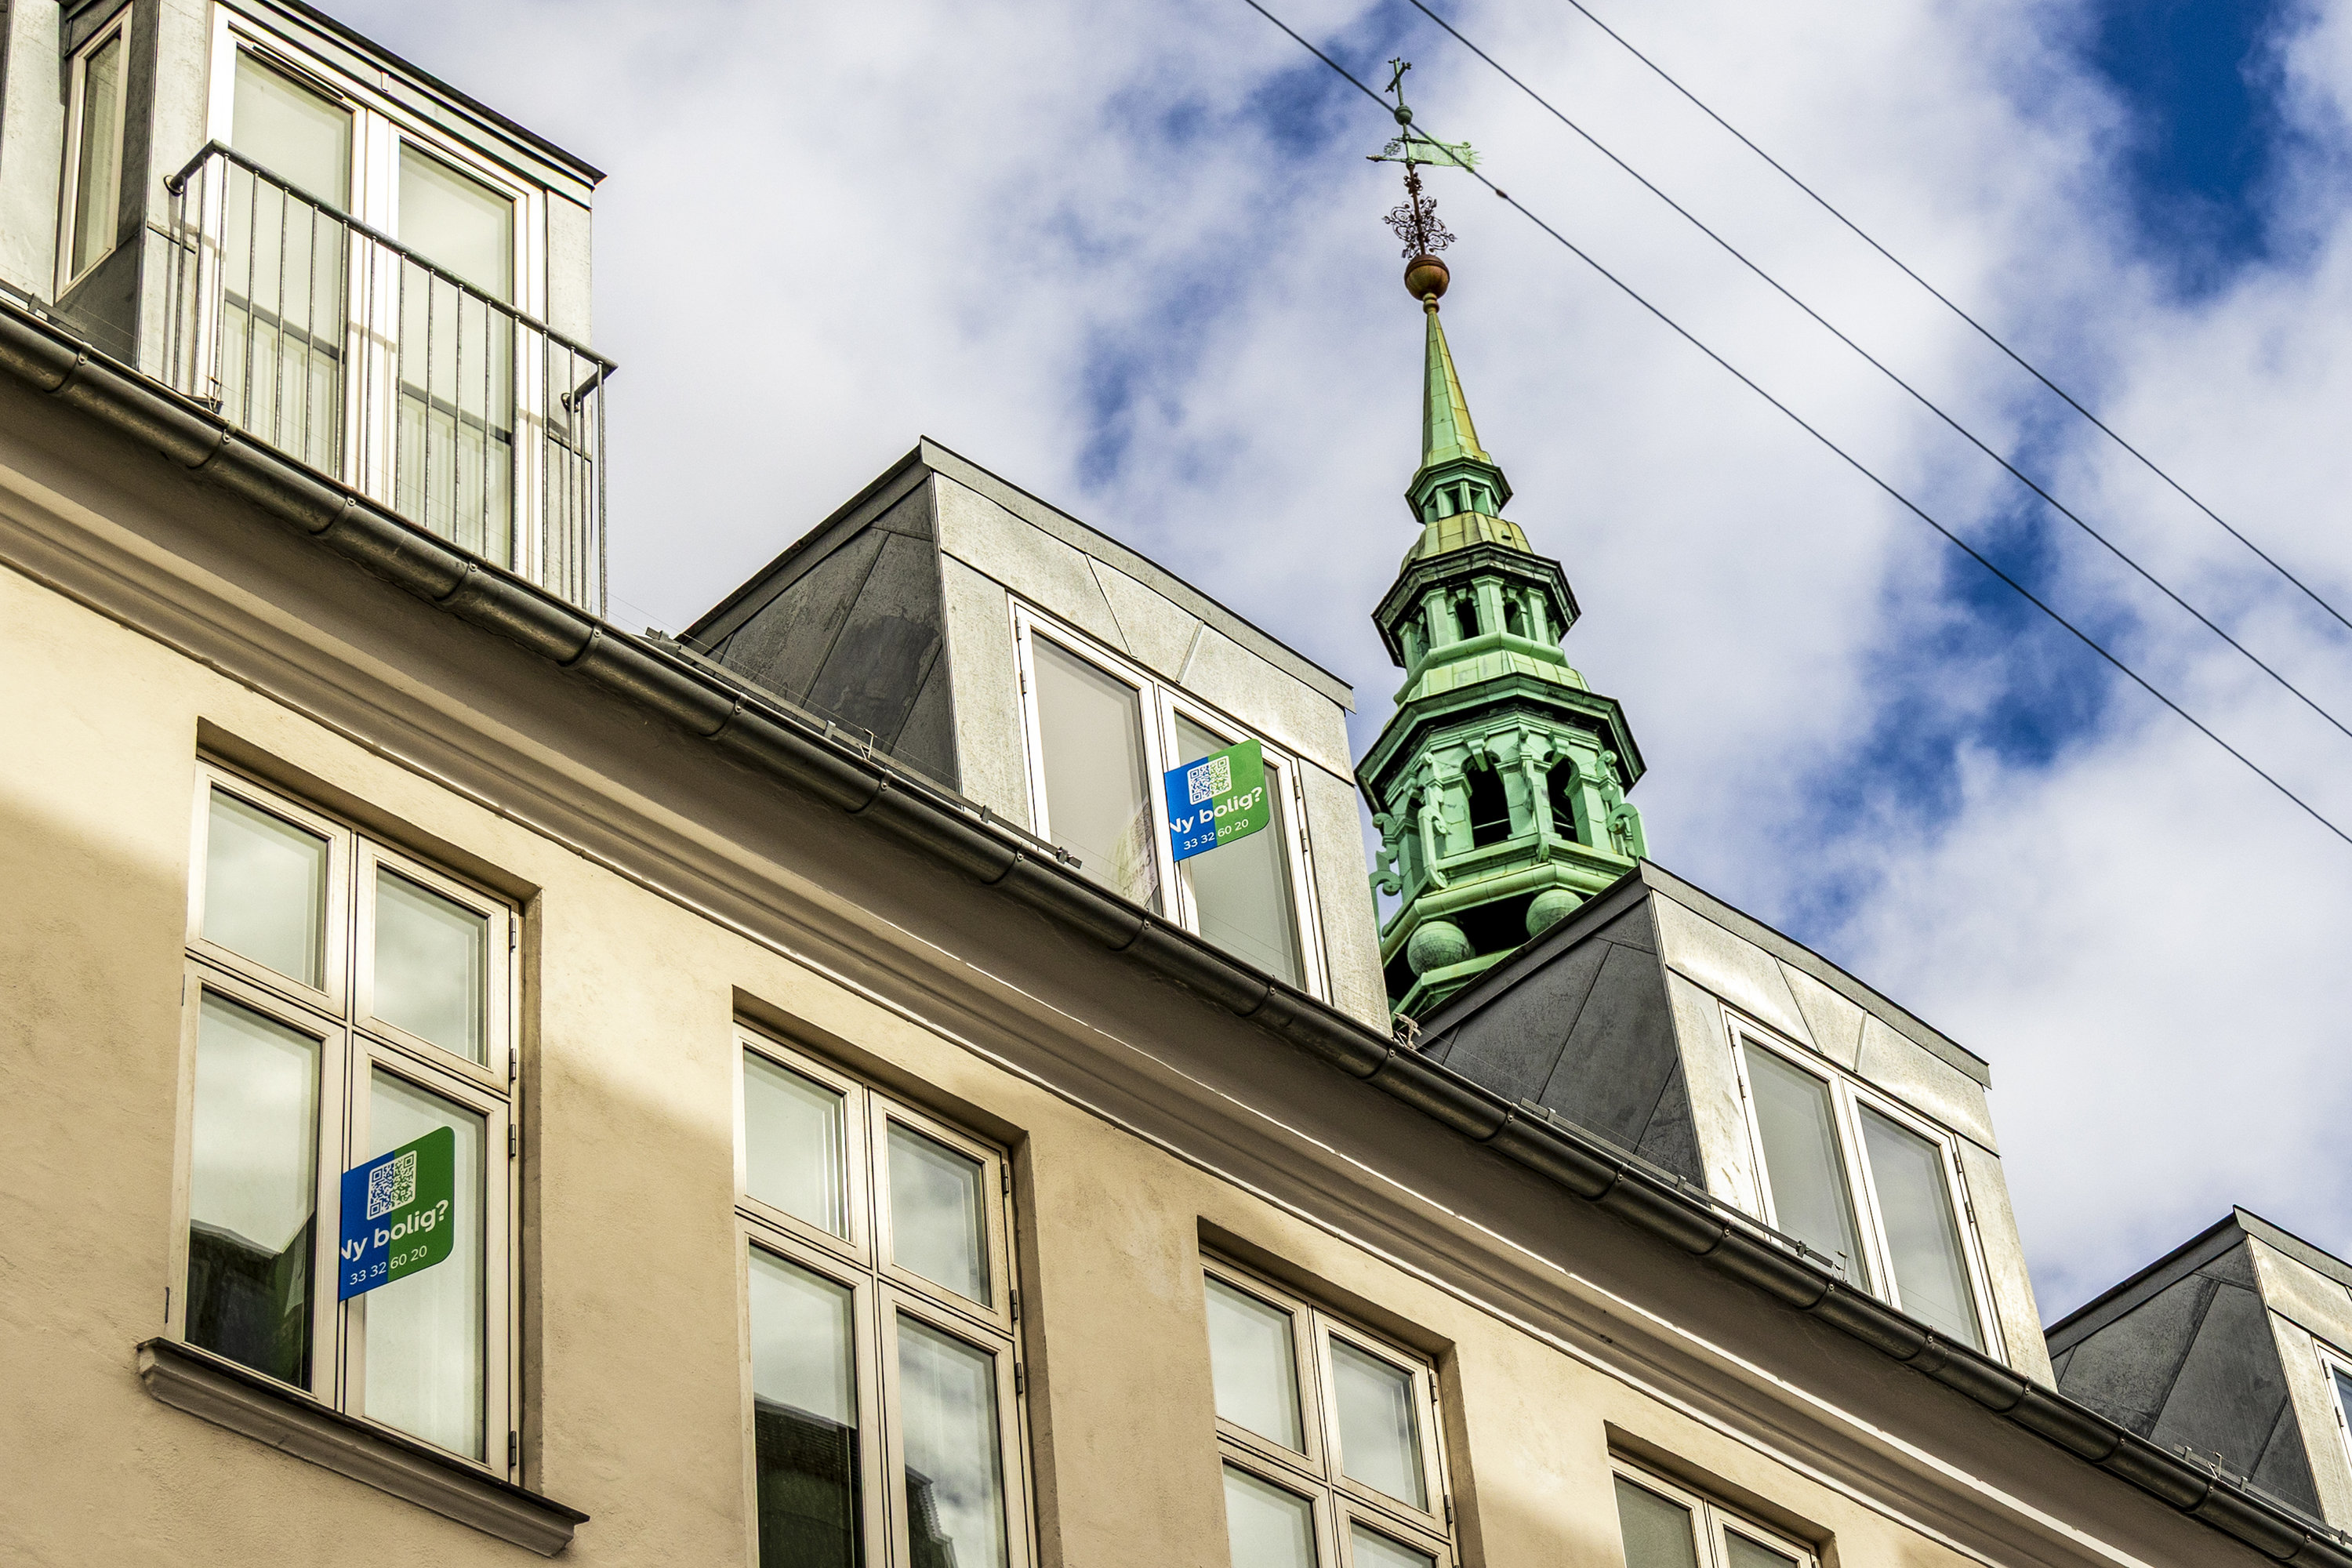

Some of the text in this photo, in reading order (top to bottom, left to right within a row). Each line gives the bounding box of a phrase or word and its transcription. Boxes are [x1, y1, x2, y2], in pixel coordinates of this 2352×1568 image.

[1199, 786, 1263, 824] bolig?
[1183, 818, 1249, 850] 33 32 60 20
[373, 1199, 449, 1248] bolig?
[349, 1245, 428, 1285] 33 32 60 20
